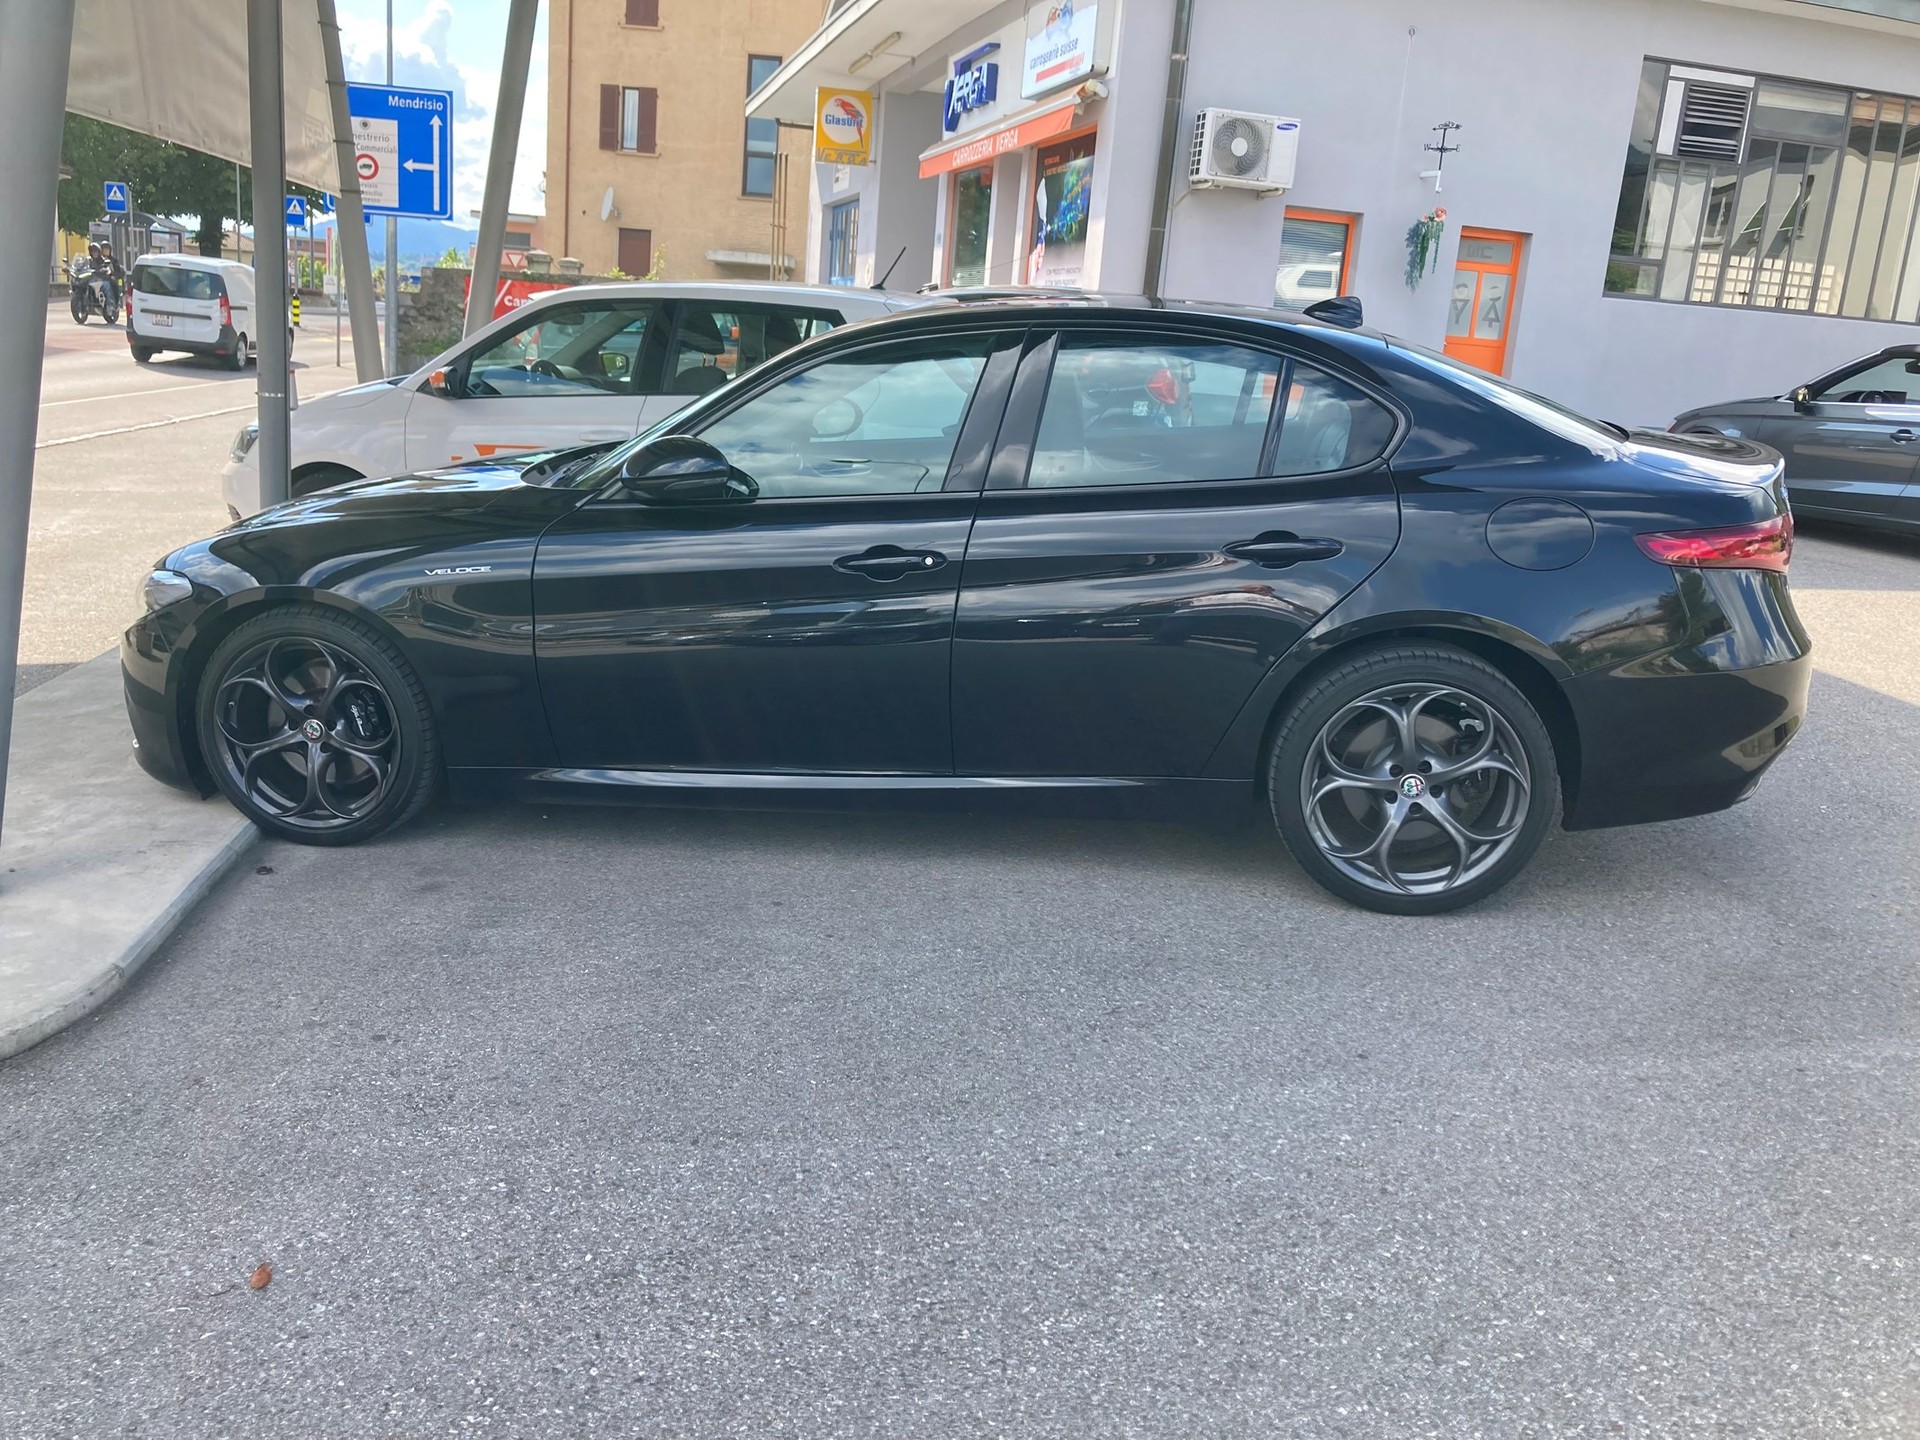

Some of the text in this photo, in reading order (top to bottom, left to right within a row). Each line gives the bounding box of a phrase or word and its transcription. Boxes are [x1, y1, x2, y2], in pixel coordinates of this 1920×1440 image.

[388, 94, 444, 111] Mendrisio
[952, 127, 1018, 168] CARROZZERIA VERGA
[424, 566, 492, 576] VELOCE
